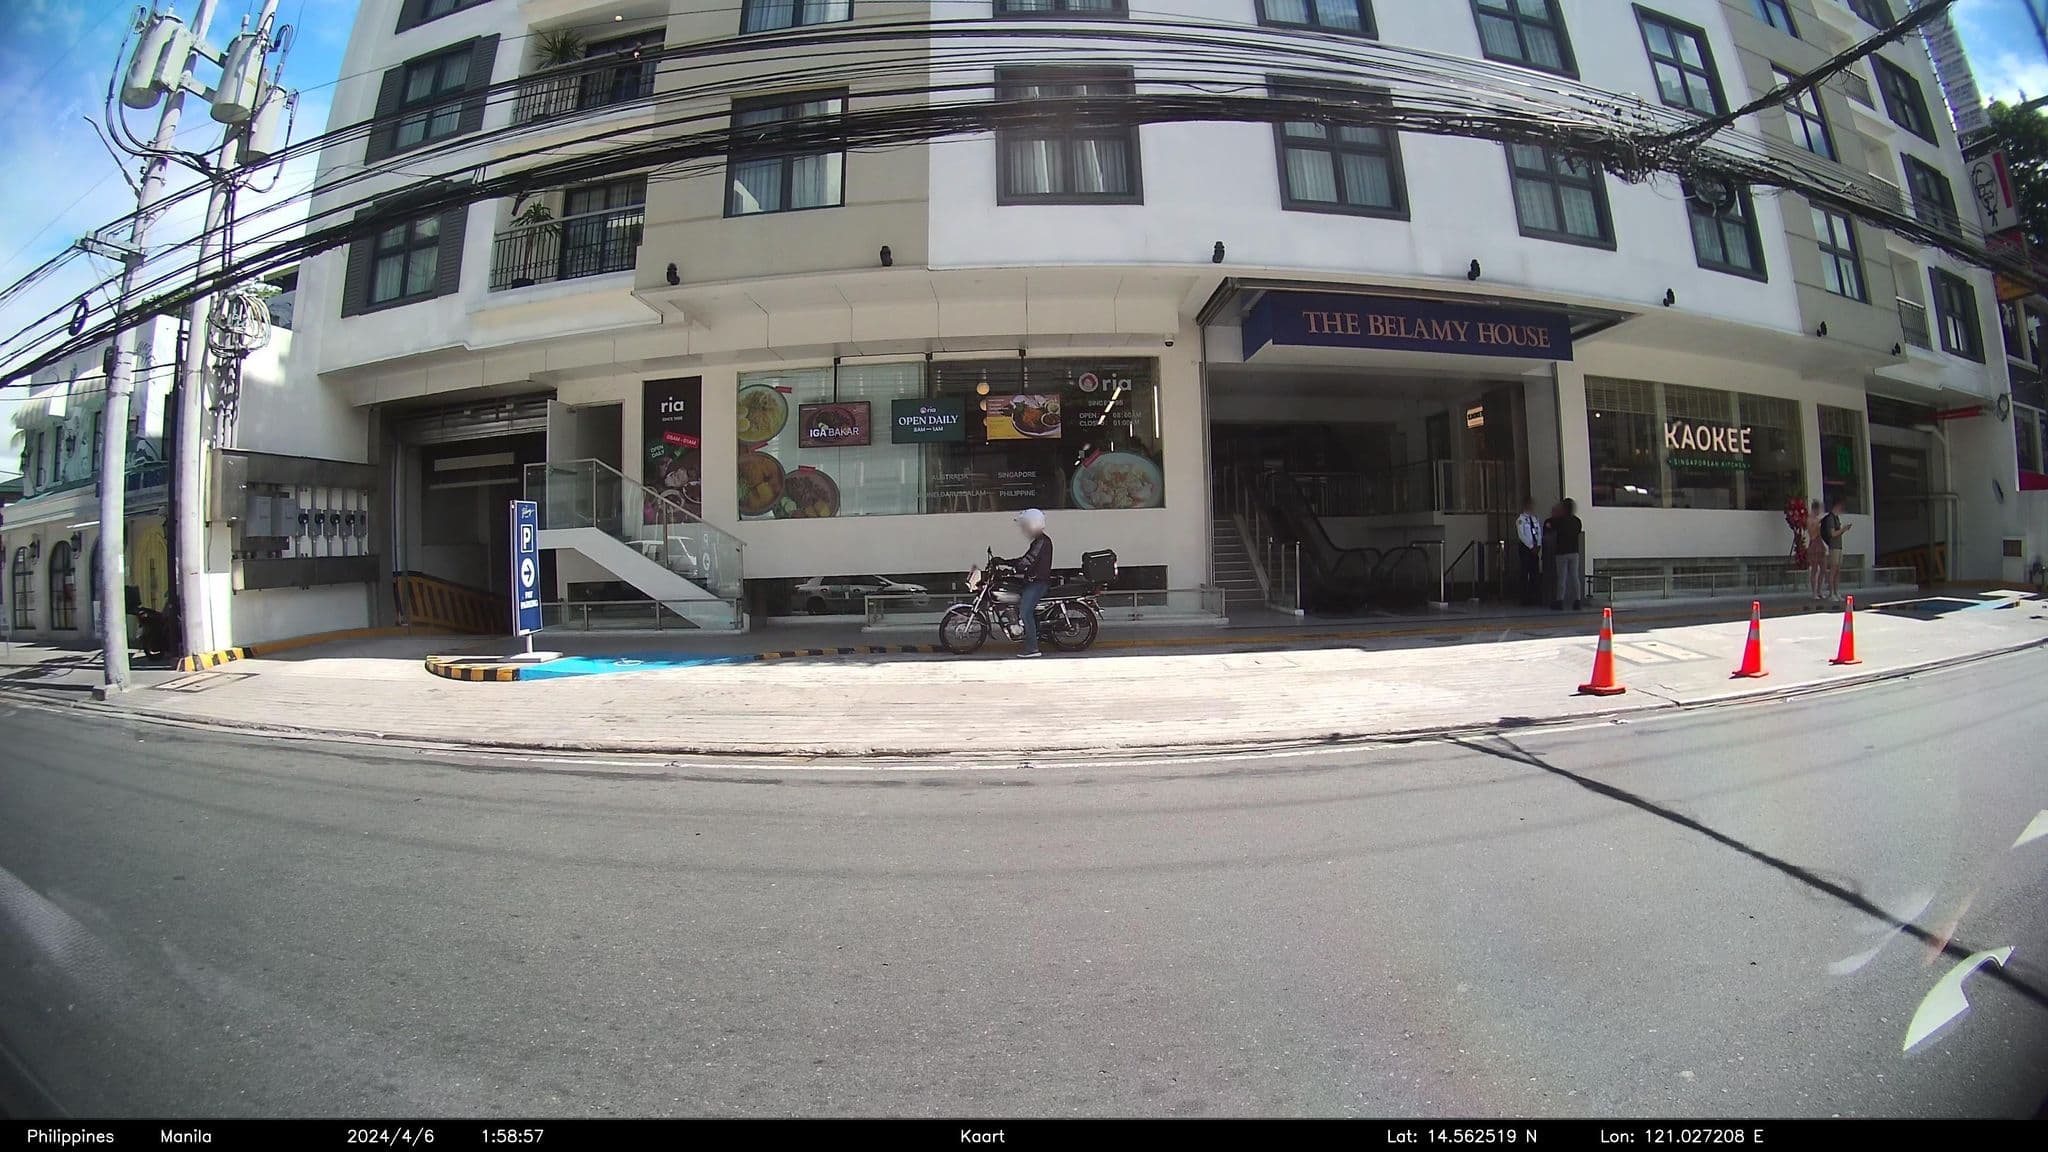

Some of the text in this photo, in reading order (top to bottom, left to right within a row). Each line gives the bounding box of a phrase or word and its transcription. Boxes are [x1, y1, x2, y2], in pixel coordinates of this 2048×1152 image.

[1303, 311, 1551, 348] THE BELAMY HOUSE
[1102, 373, 1132, 391] ria
[661, 396, 685, 413] ria
[899, 415, 959, 426] OPEN DAILY
[809, 427, 860, 438] IGA BAKAR
[1664, 422, 1752, 454] KAOKEE
[997, 471, 1037, 479] SINGAPORE
[522, 527, 531, 550] P
